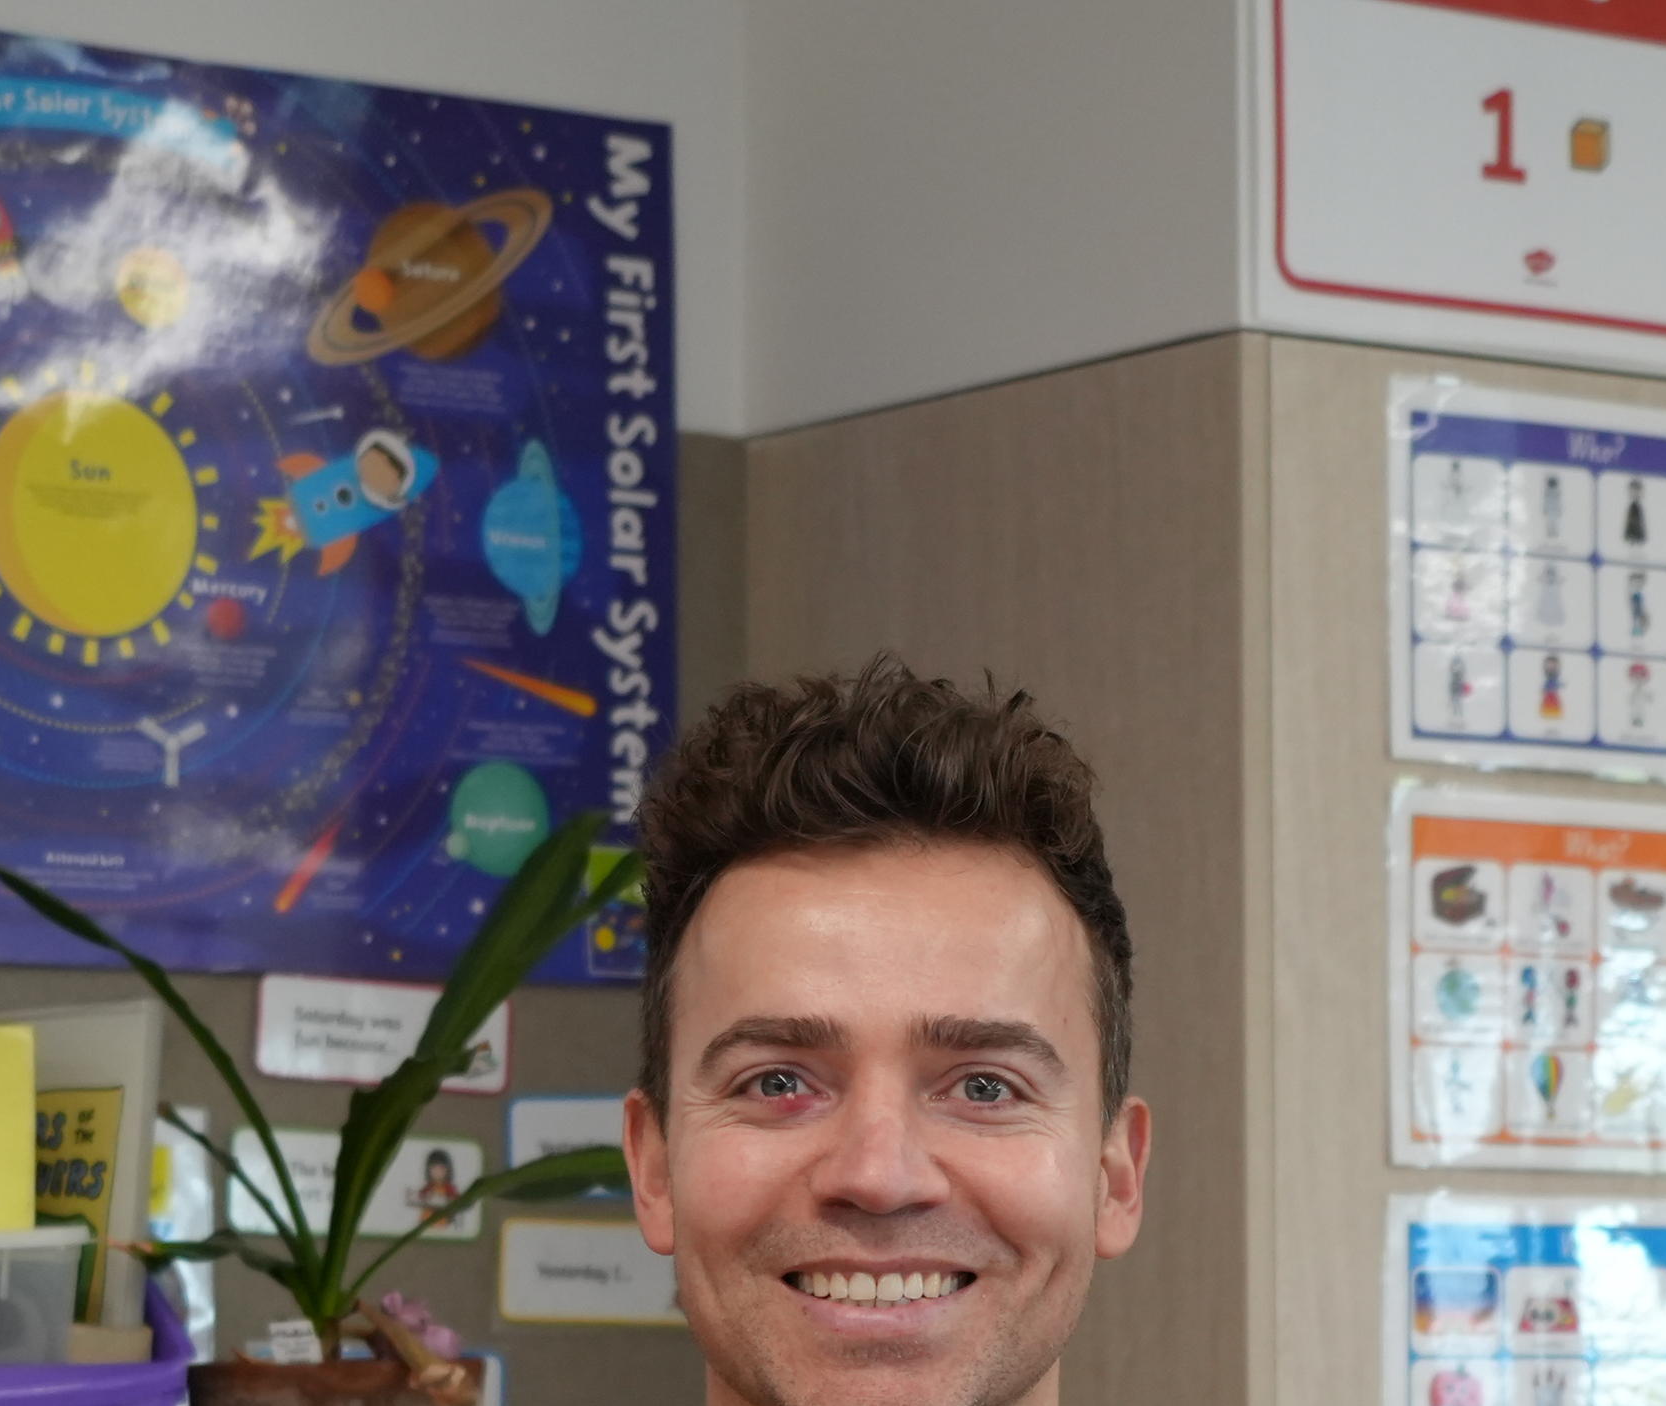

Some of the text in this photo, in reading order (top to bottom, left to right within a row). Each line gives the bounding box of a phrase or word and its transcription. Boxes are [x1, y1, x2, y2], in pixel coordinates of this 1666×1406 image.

[1481, 87, 1527, 184] 1
[70, 460, 112, 482] Sun
[589, 133, 660, 824] My First Solar System
[193, 578, 268, 602] Mercury
